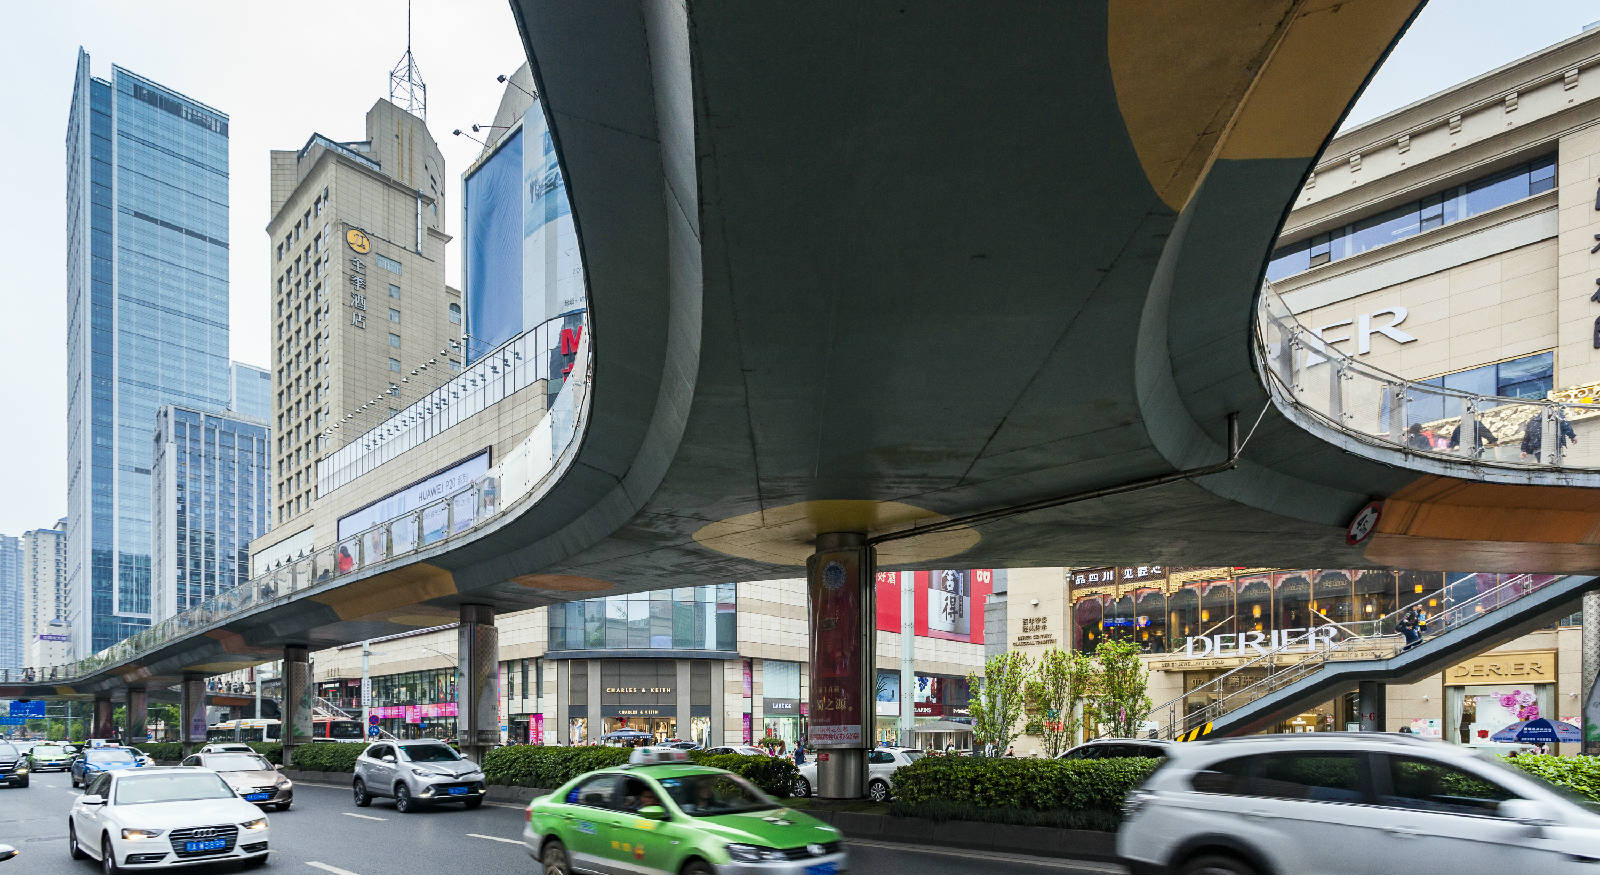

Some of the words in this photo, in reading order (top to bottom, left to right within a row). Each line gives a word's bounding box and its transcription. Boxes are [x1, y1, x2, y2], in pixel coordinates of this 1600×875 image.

[350, 257, 367, 329] 全季酒店
[418, 483, 444, 502] HUAWEI
[1072, 571, 1114, 585] 品四川
[1186, 625, 1339, 659] DERIER
[1454, 662, 1544, 678] DERIER
